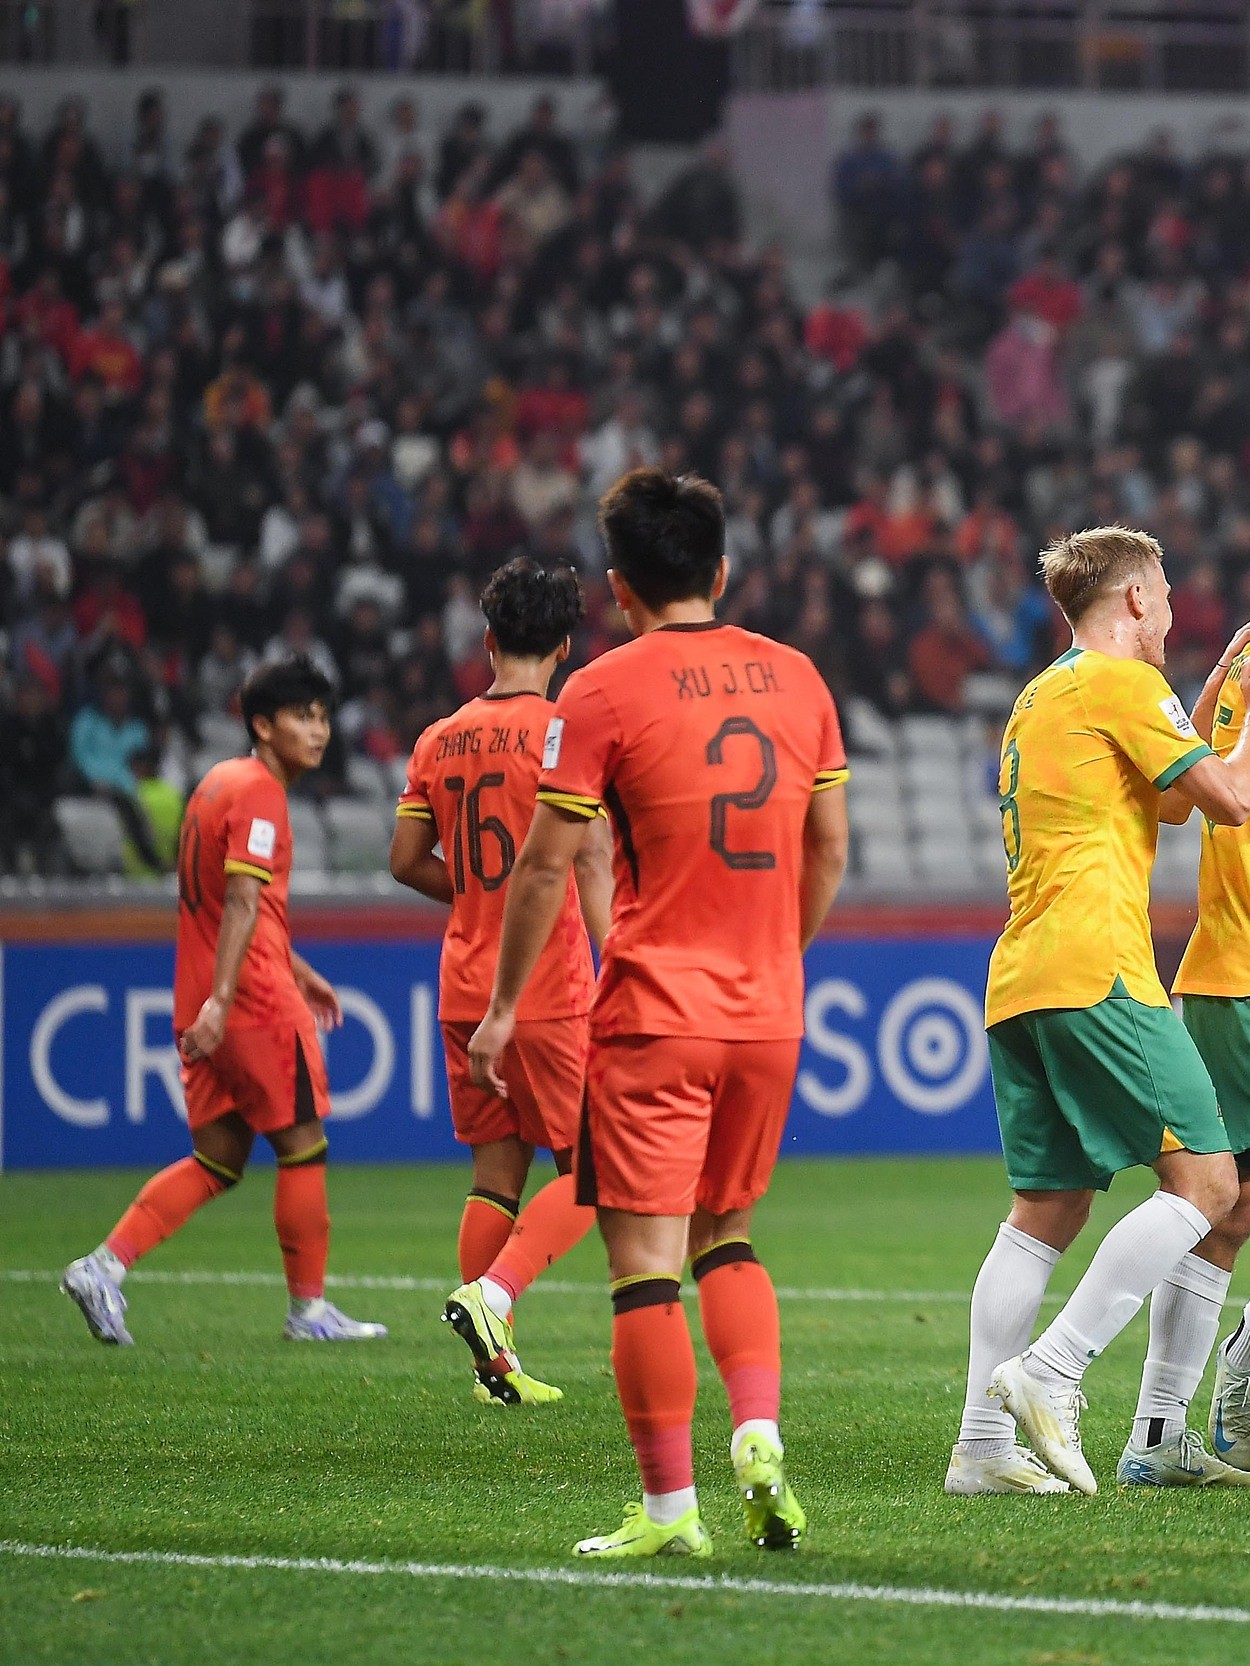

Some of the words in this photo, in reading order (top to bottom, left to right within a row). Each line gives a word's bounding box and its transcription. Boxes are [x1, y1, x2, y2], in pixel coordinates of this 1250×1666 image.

[671, 666, 711, 699] XU
[436, 728, 483, 762] ZHANG
[706, 716, 777, 870] 2
[445, 772, 515, 895] 16
